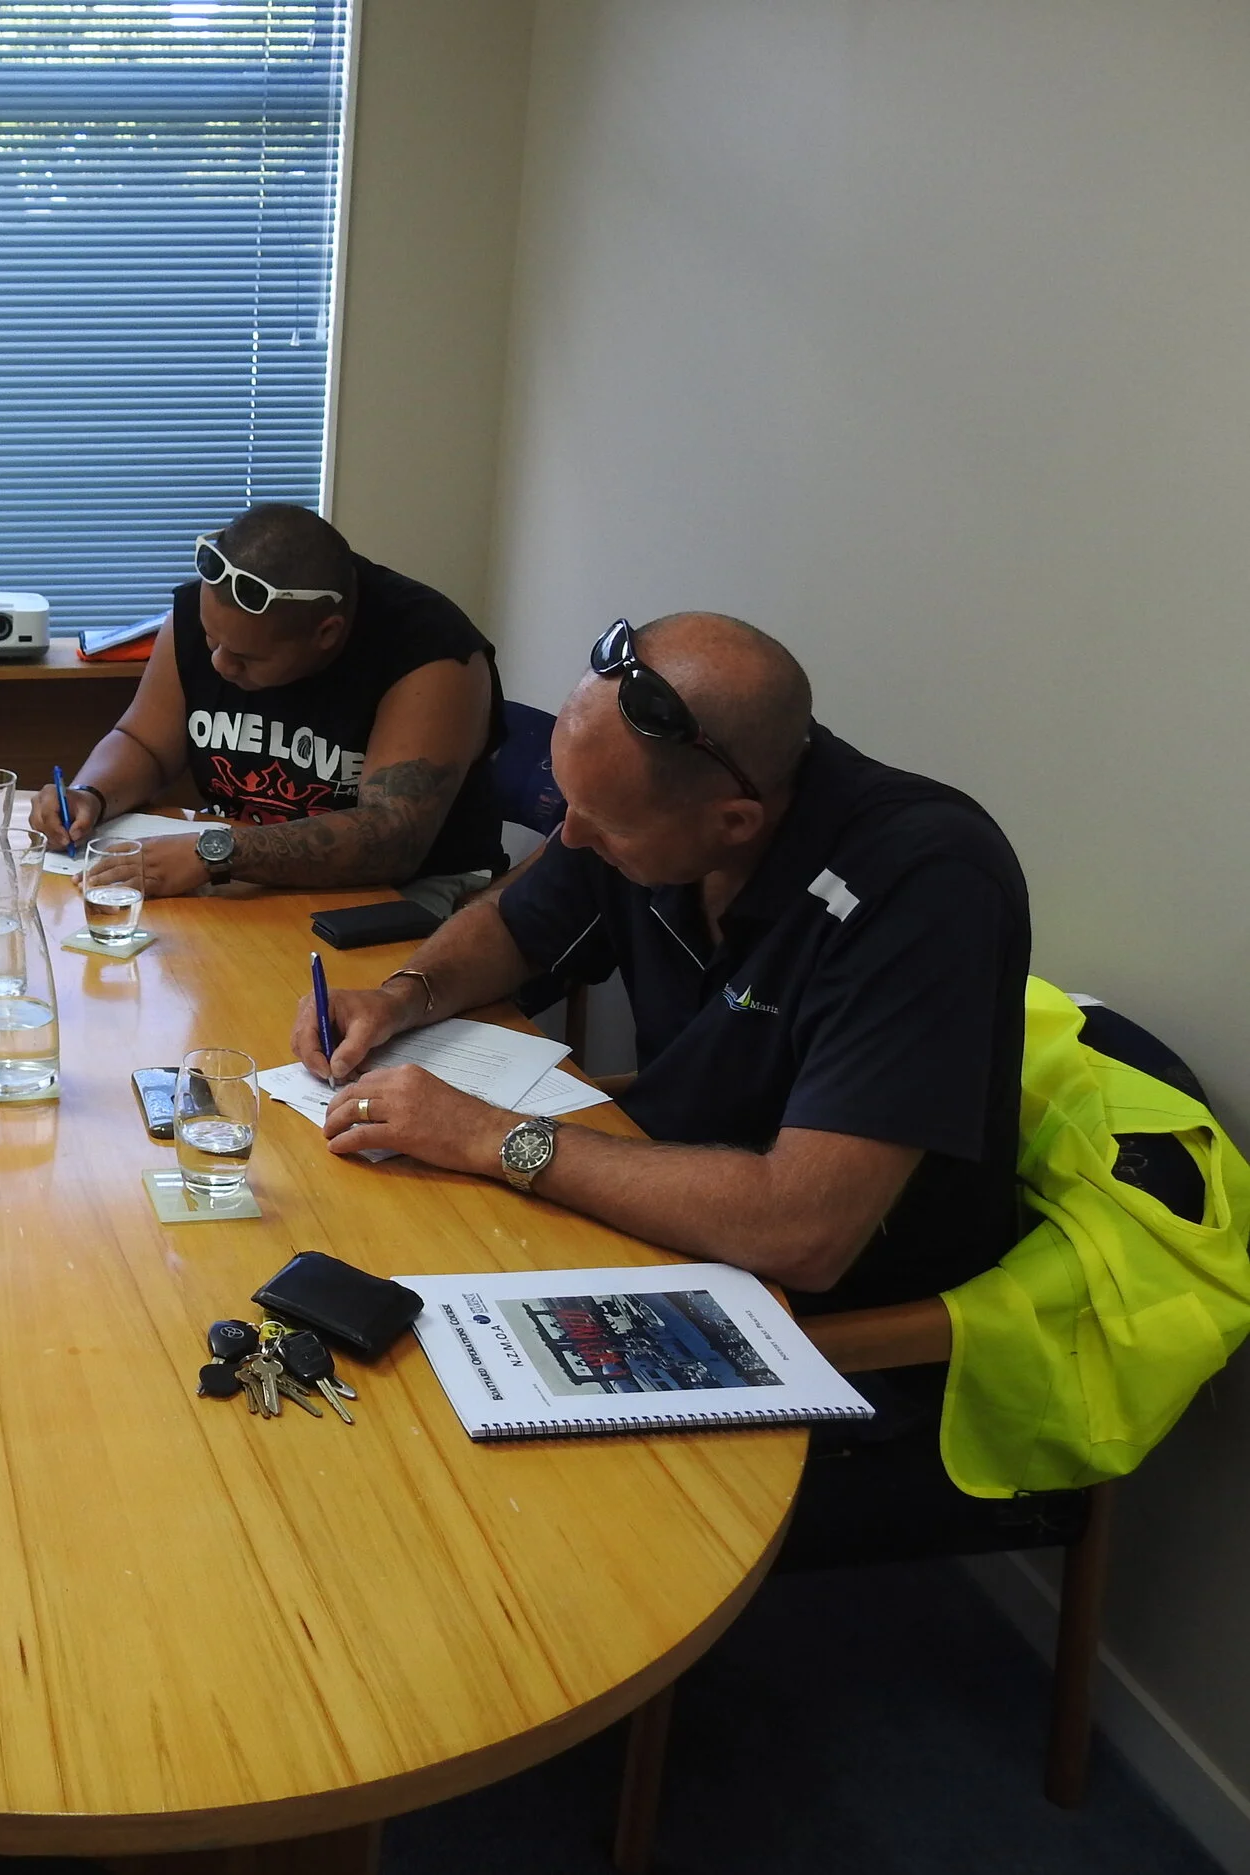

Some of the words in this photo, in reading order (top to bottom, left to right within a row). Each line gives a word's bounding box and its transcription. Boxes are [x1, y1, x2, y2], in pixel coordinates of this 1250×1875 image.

[188, 710, 263, 754] ONE
[269, 721, 365, 786] LOVE
[441, 1303, 459, 1326] COURSE
[456, 1327, 482, 1366] OPERATIONS
[478, 1367, 504, 1401] BOATYARD
